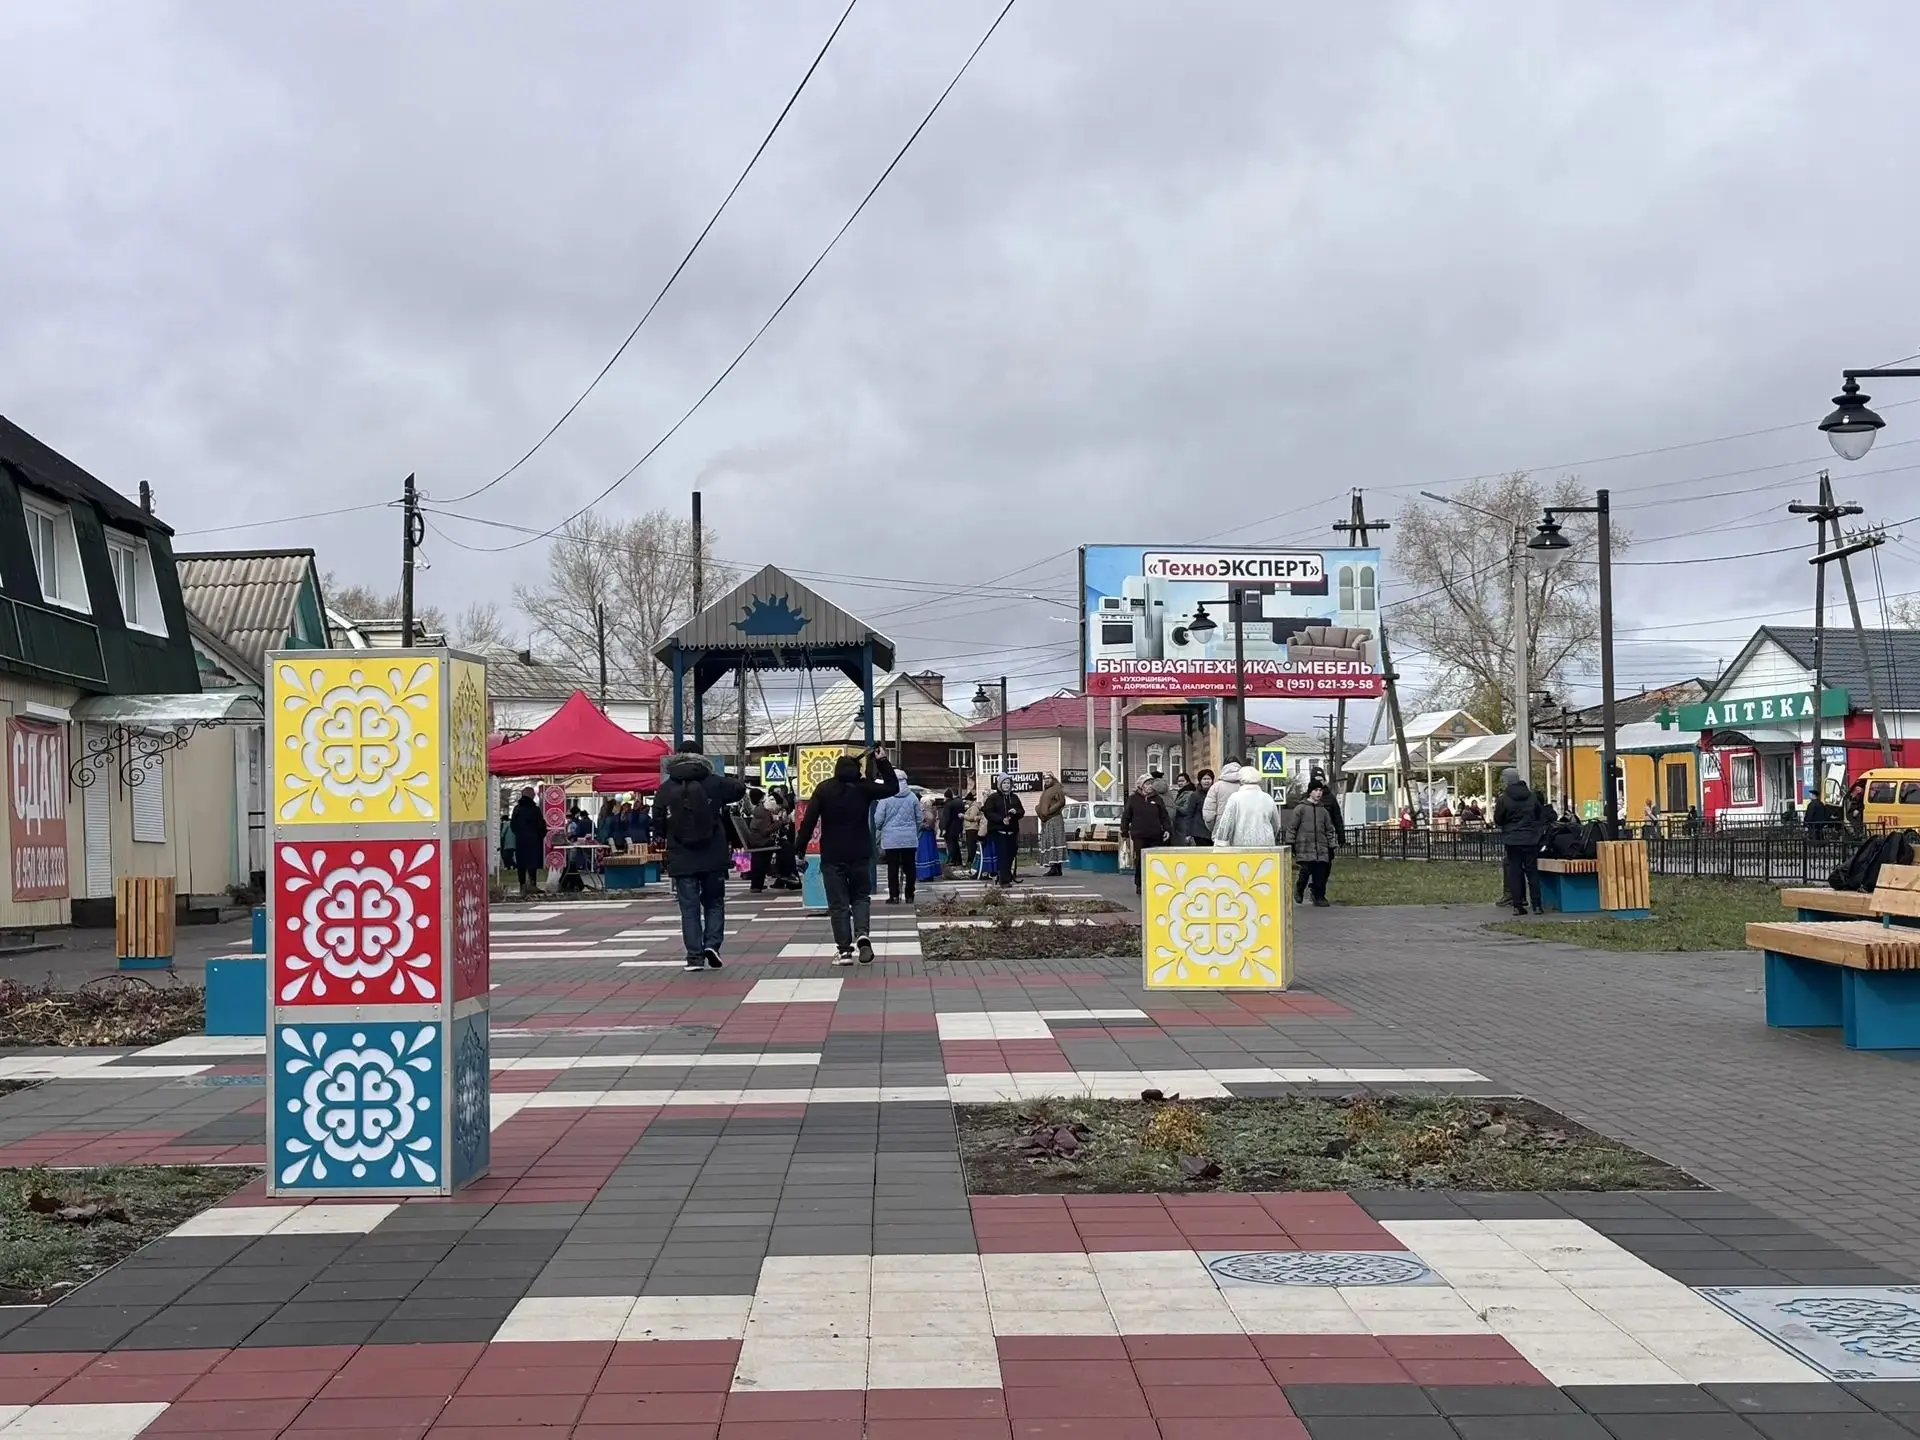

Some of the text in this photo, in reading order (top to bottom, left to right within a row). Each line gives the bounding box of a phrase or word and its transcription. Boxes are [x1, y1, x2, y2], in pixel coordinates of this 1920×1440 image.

[1148, 559, 1320, 577] «ТехноЭКСПЕРТ»
[1097, 660, 1372, 675] БЫТОВАЯ ТЕХНИКА МЕБЕЛЬ
[1276, 679, 1374, 691] 8 (951) 621-39-58
[1704, 695, 1815, 726] АПТЕКА
[16, 847, 21, 889] 8
